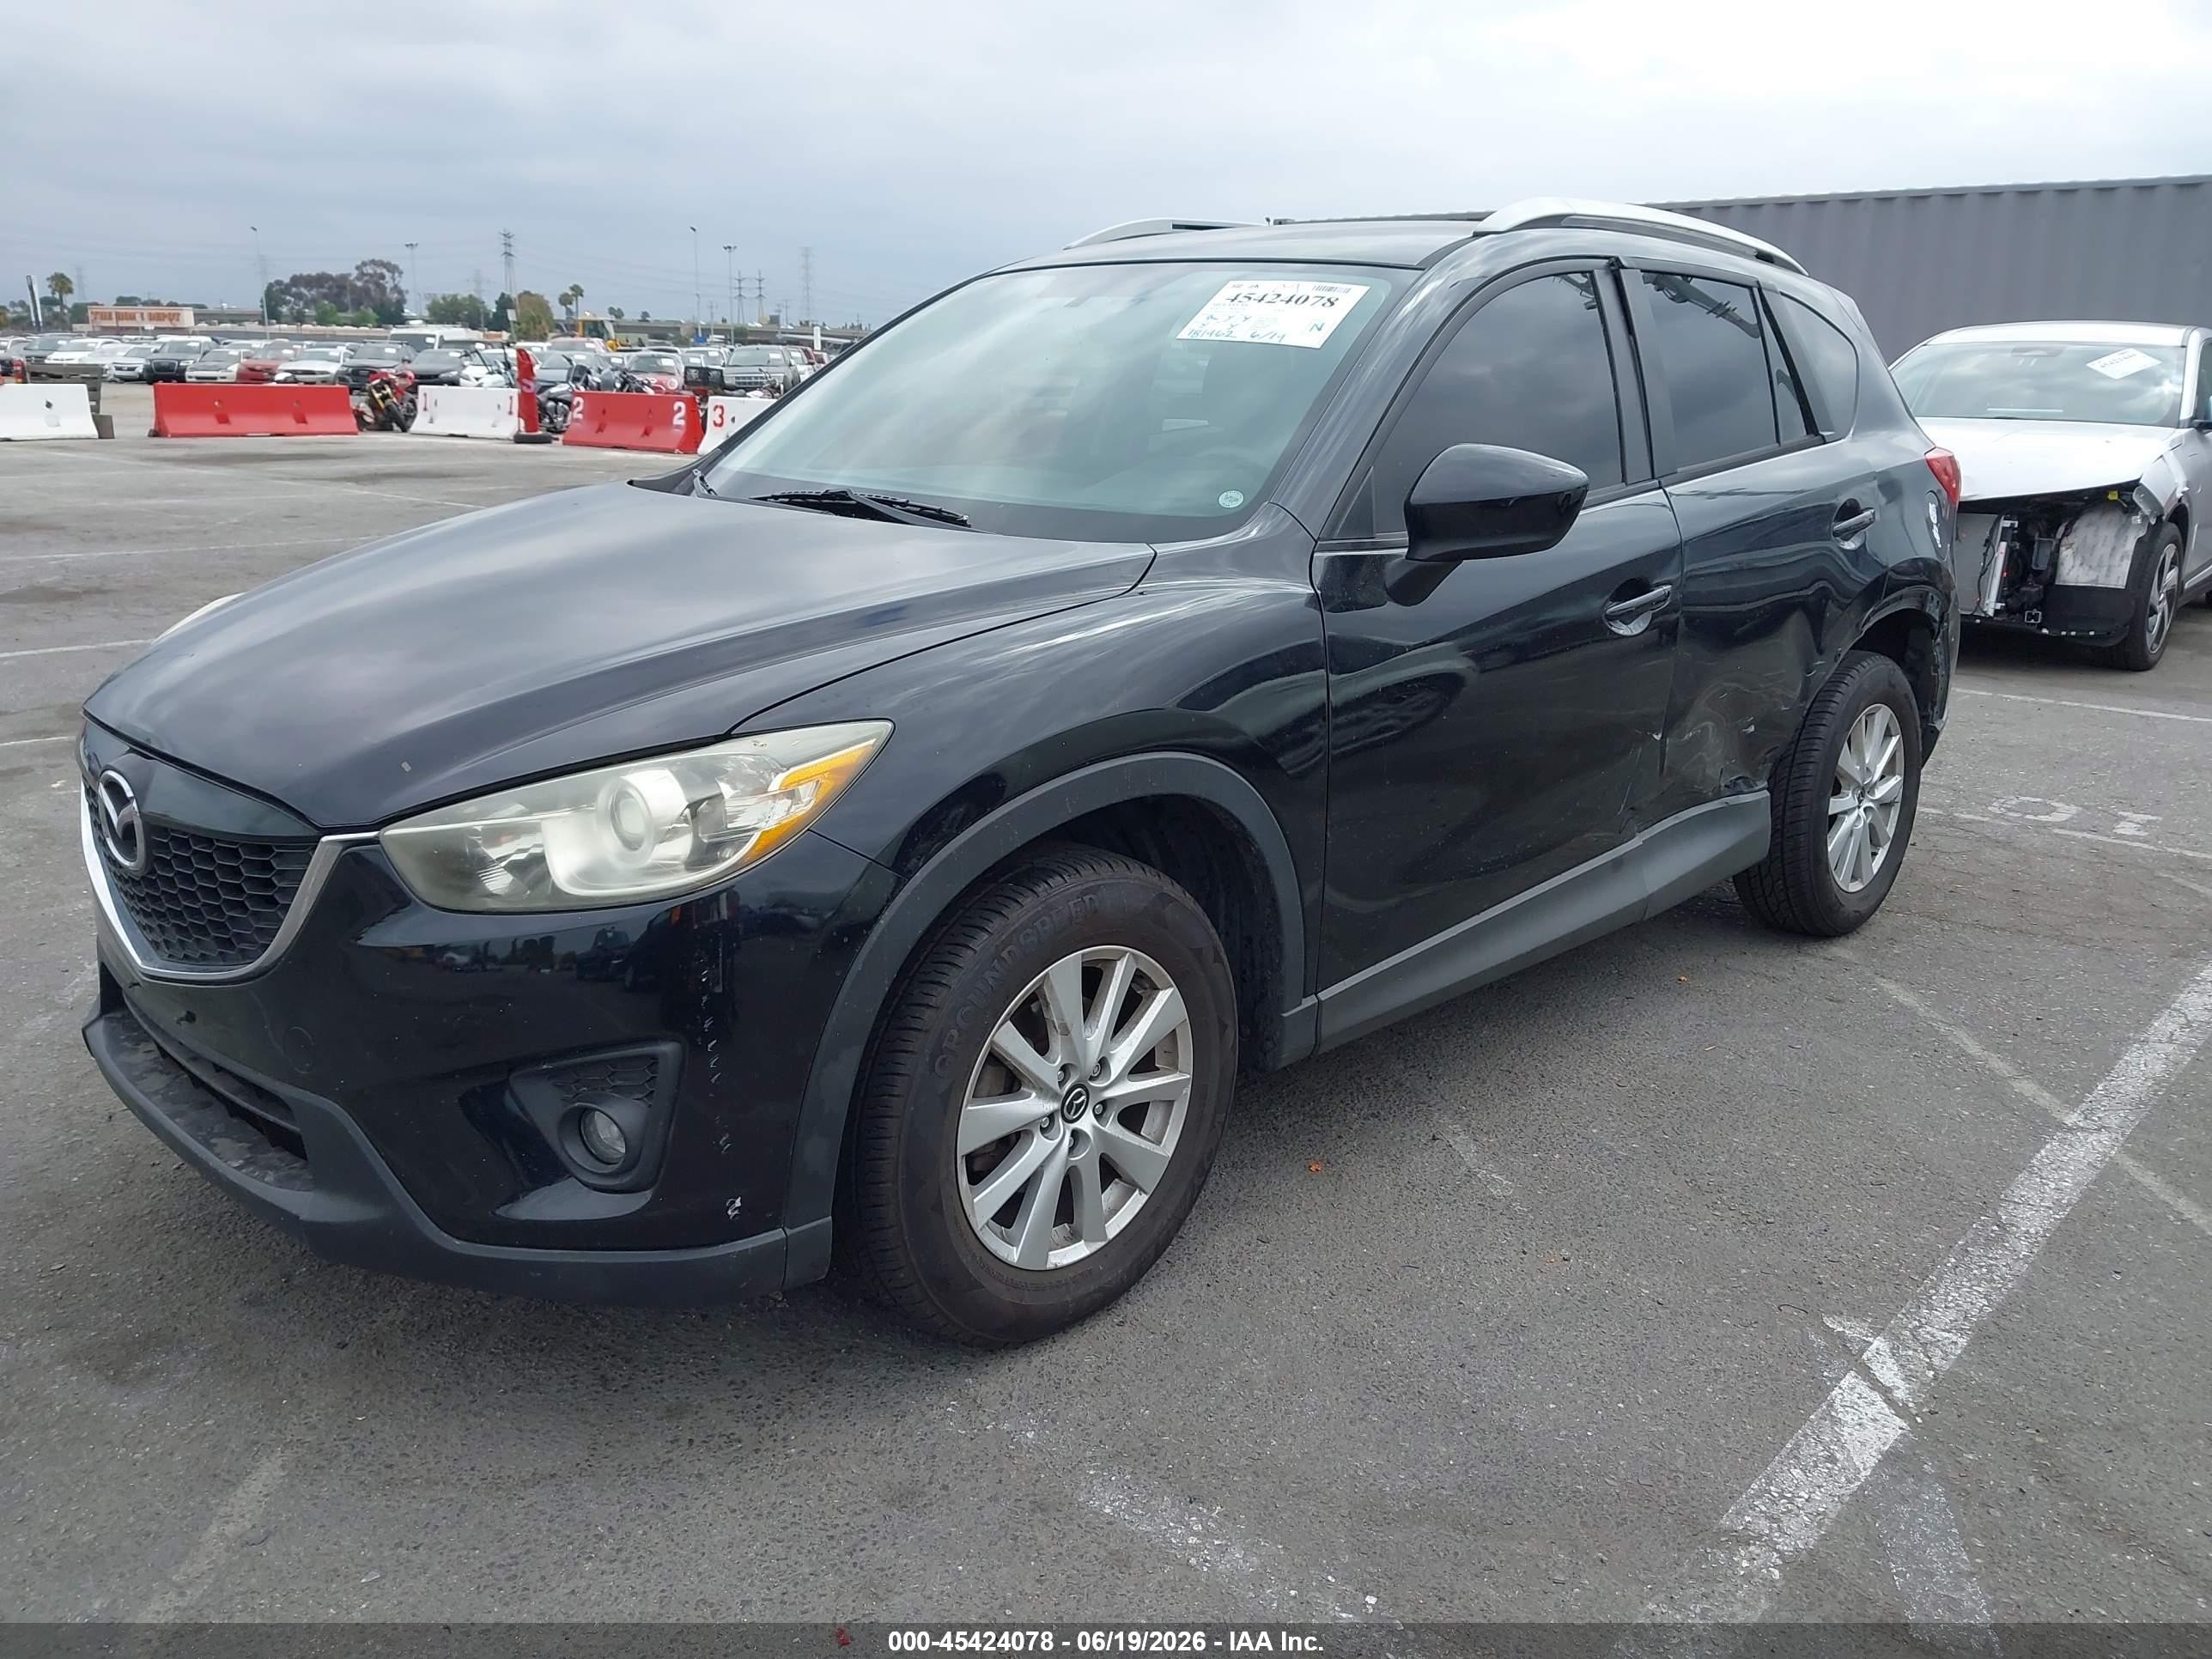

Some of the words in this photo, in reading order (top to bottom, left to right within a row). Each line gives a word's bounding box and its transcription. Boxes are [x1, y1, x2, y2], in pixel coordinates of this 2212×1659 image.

[1225, 293, 1339, 307] 45424078
[1309, 323, 1325, 332] N
[422, 392, 428, 411] 1
[508, 396, 514, 415] 1
[572, 396, 585, 420] 2
[672, 401, 686, 426] 2
[713, 404, 725, 428] 3
[934, 894, 1099, 1079] GROUNDSPEED
